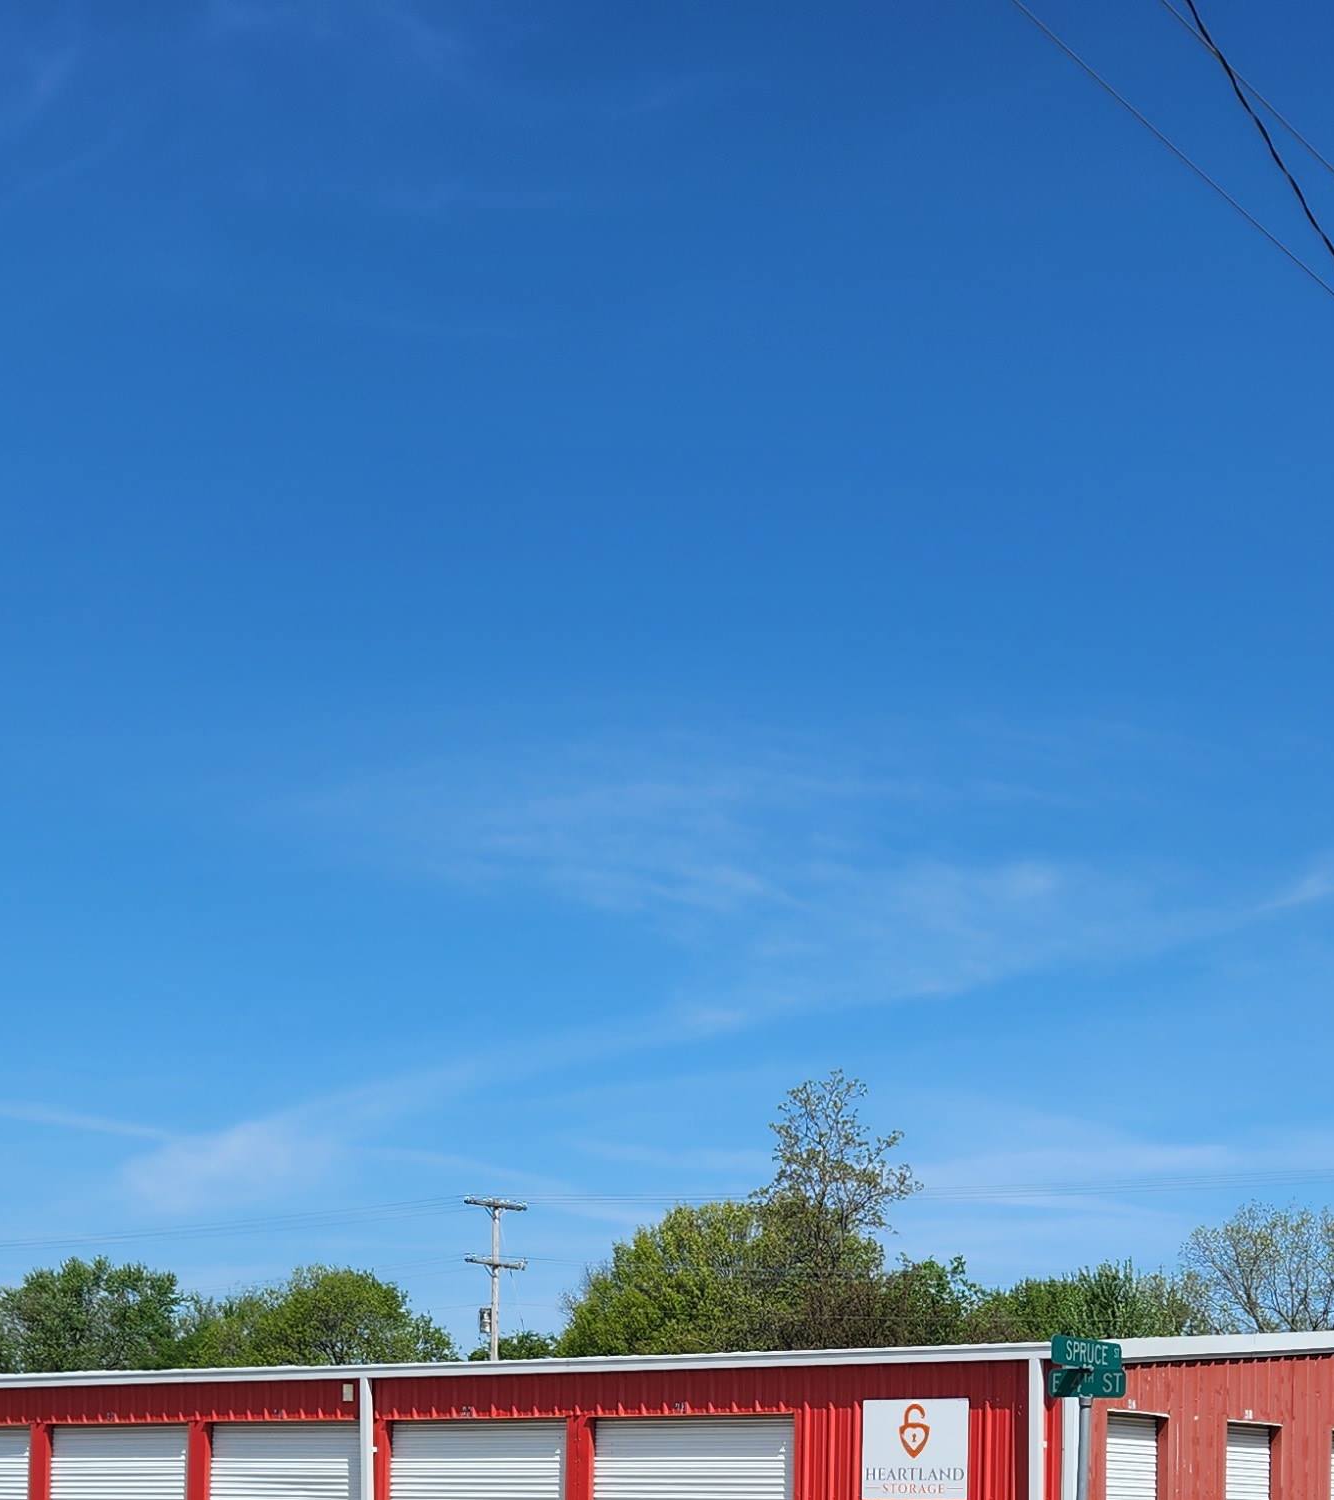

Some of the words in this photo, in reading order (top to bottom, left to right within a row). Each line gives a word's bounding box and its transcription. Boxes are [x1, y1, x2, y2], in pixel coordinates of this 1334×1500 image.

[1066, 1340, 1108, 1365] SPRUCE
[1114, 1348, 1120, 1358] ST
[1052, 1372, 1062, 1393] E
[1102, 1372, 1123, 1393] ST
[865, 1467, 965, 1481] HEARTLAND
[882, 1482, 945, 1494] STORAGE
